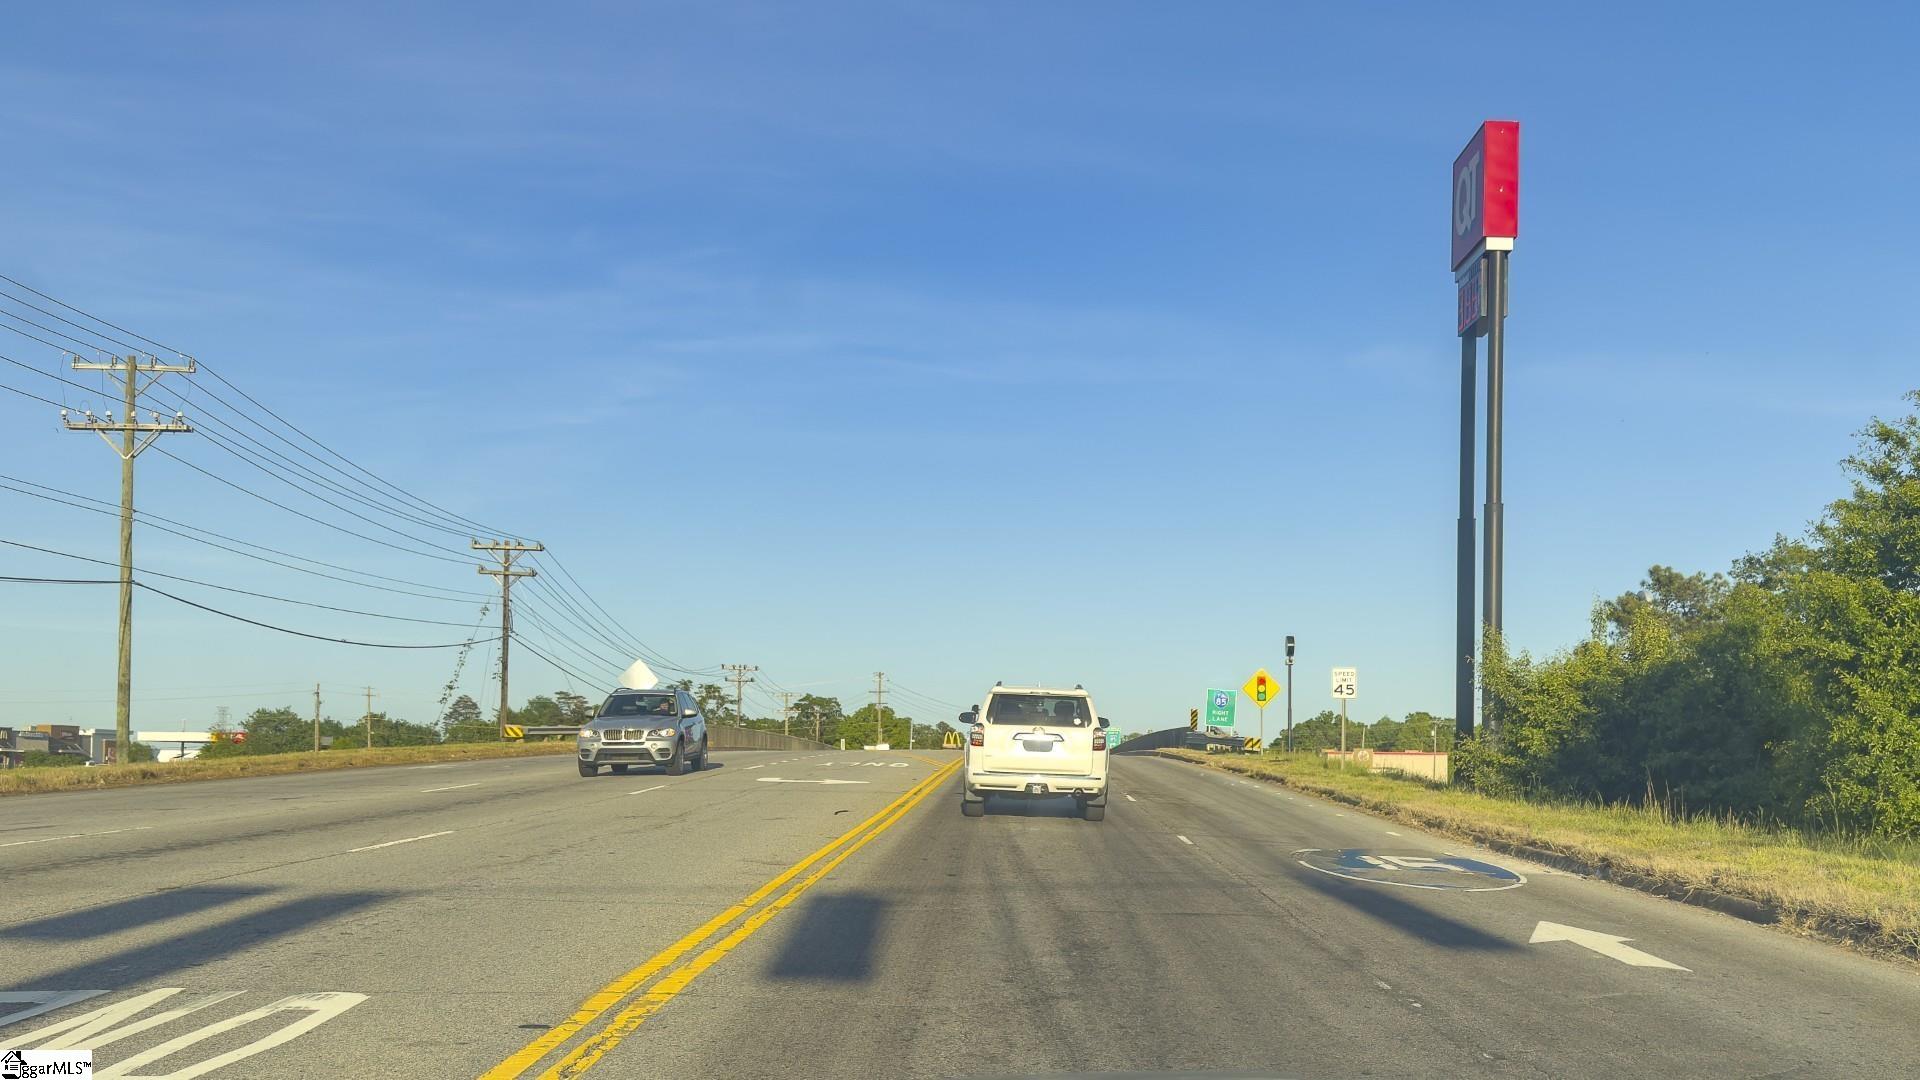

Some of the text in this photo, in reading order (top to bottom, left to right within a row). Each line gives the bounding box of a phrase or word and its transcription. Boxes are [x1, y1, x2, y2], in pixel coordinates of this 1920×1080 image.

[1456, 151, 1480, 235] QT
[1334, 684, 1354, 695] 45
[1215, 697, 1226, 705] 85
